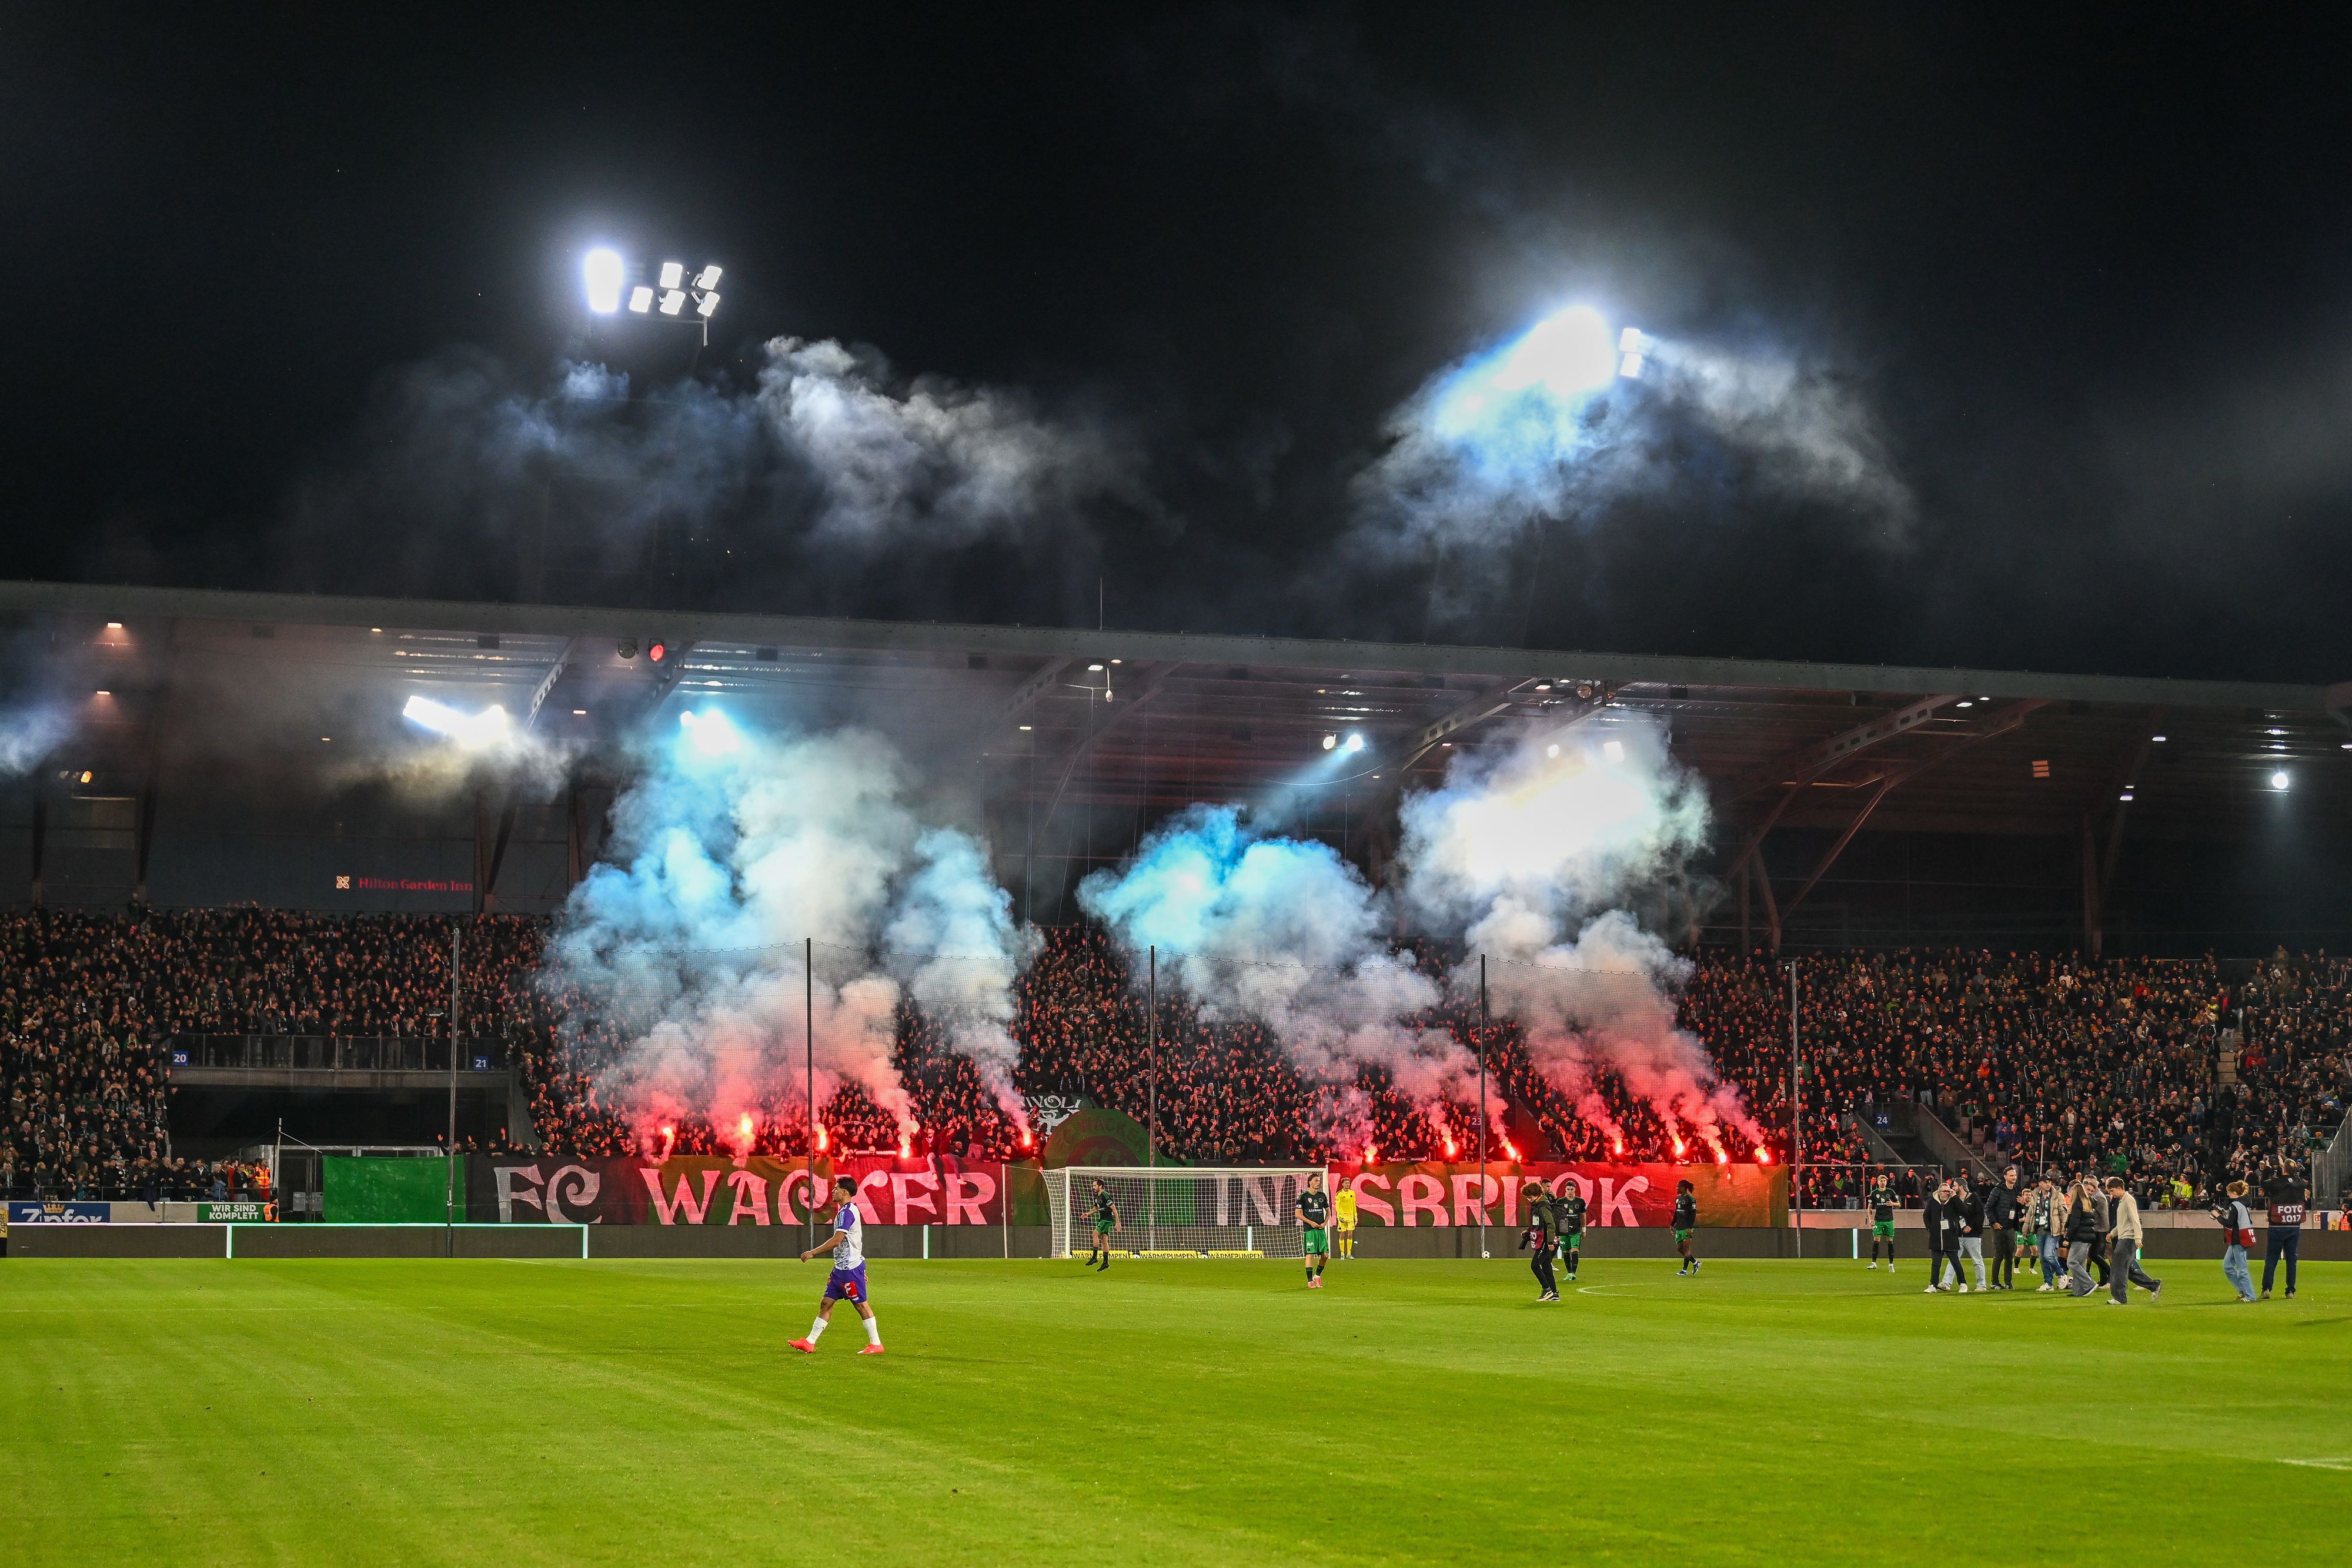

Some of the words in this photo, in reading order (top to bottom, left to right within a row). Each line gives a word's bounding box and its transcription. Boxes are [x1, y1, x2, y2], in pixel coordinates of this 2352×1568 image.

[359, 877, 399, 890] Hilton
[400, 878, 447, 891] Garden
[450, 880, 473, 891] Inn
[173, 1054, 186, 1062] 20
[475, 1059, 486, 1068] 21
[1020, 1095, 1083, 1109] IVOLI
[493, 1164, 603, 1224] FC
[639, 1167, 996, 1226] WACKER
[2277, 1205, 2303, 1214] FOTO
[209, 1212, 259, 1220] KOMPLETT
